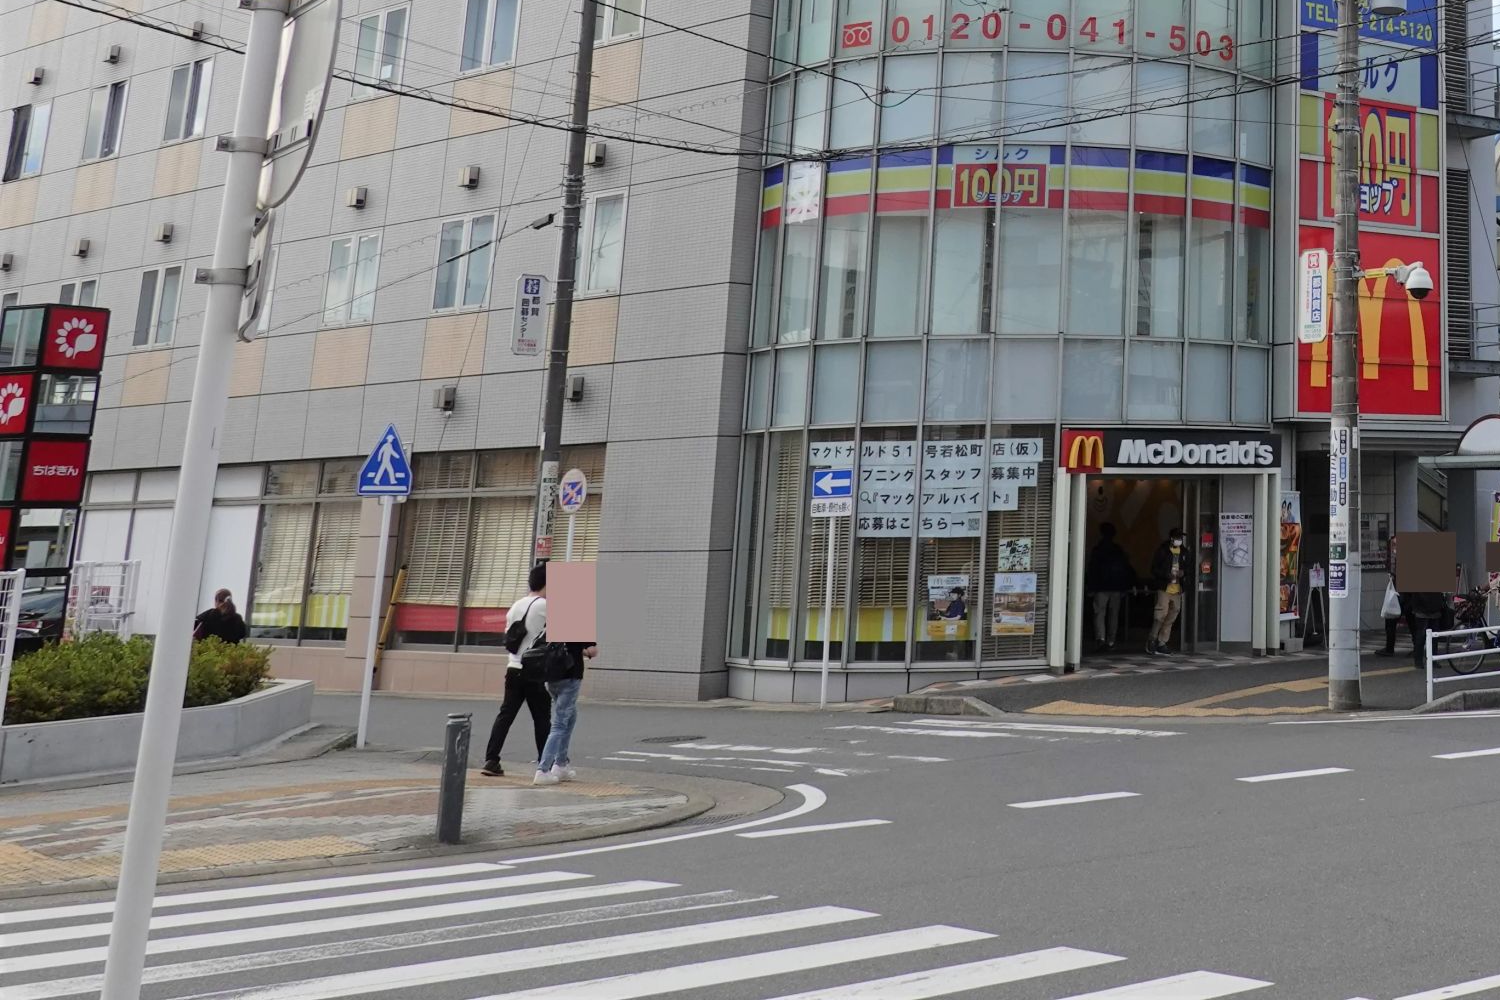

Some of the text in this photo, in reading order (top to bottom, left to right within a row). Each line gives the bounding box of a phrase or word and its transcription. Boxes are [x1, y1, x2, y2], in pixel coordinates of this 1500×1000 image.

[891, 12, 1235, 62] 0120-041-503
[975, 147, 1029, 161] シルク
[960, 168, 1040, 205] 100円
[1116, 438, 1274, 465] McDonald's
[32, 464, 79, 477] ちばぎん
